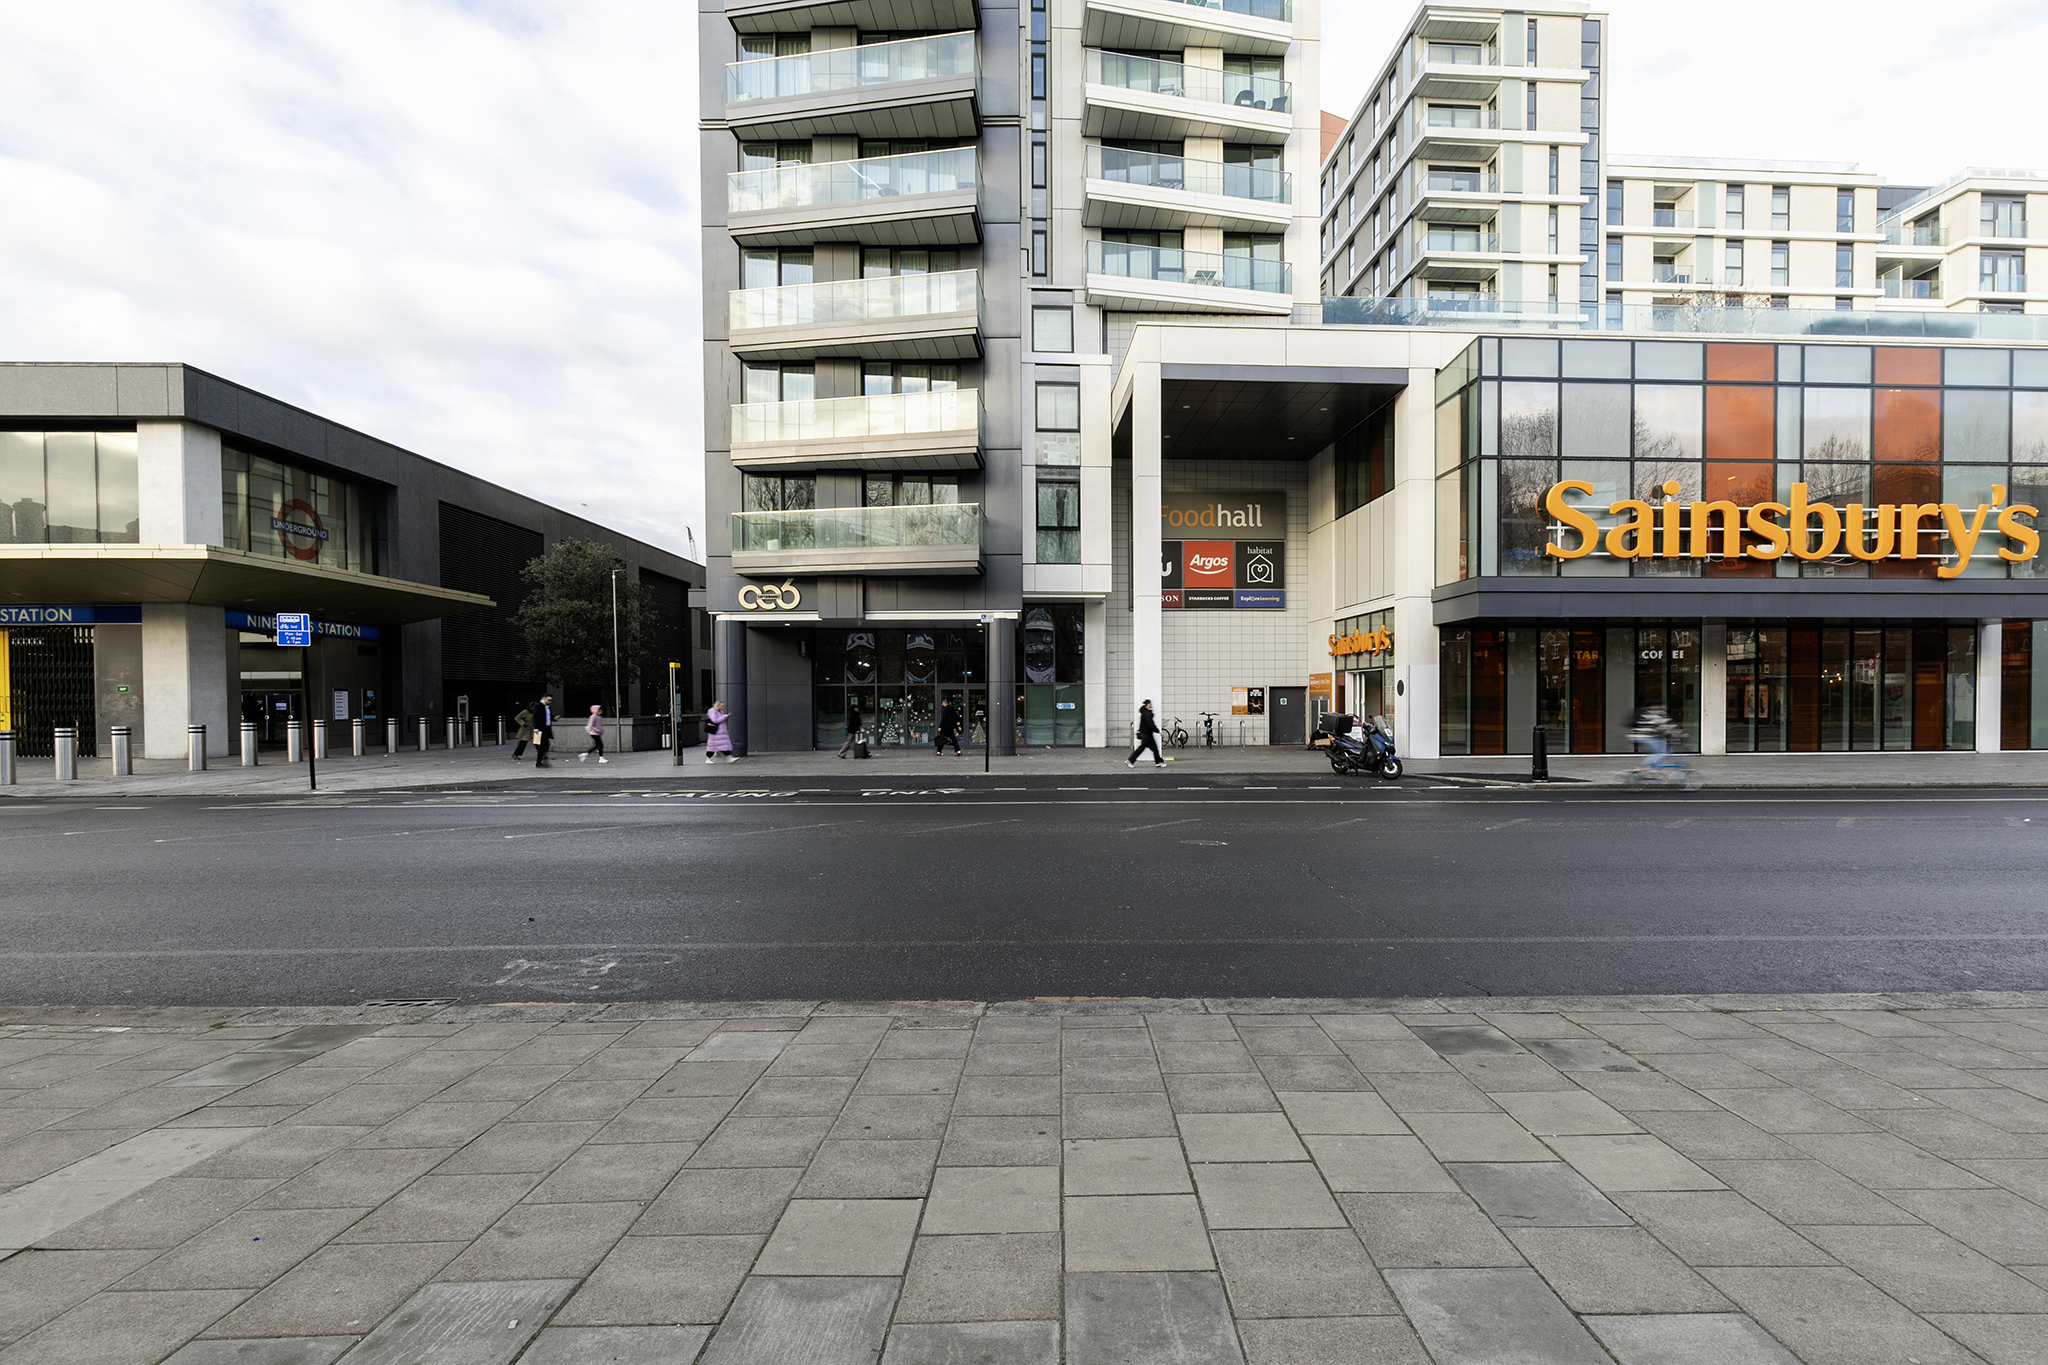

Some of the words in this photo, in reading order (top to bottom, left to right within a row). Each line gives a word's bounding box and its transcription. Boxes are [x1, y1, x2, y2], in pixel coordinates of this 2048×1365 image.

[273, 520, 327, 539] UNDERGROUND
[1545, 479, 2040, 579] Sainsbury's
[1247, 546, 1273, 554] habitat
[1189, 554, 1229, 570] Argos
[0, 608, 72, 622] STATION
[247, 615, 277, 630] NINE
[318, 622, 361, 637] STATION
[1328, 624, 1390, 657] Sainsbury's
[1573, 650, 1599, 660] TAR
[1641, 650, 1685, 660] COFEE
[608, 791, 799, 799] LOADING
